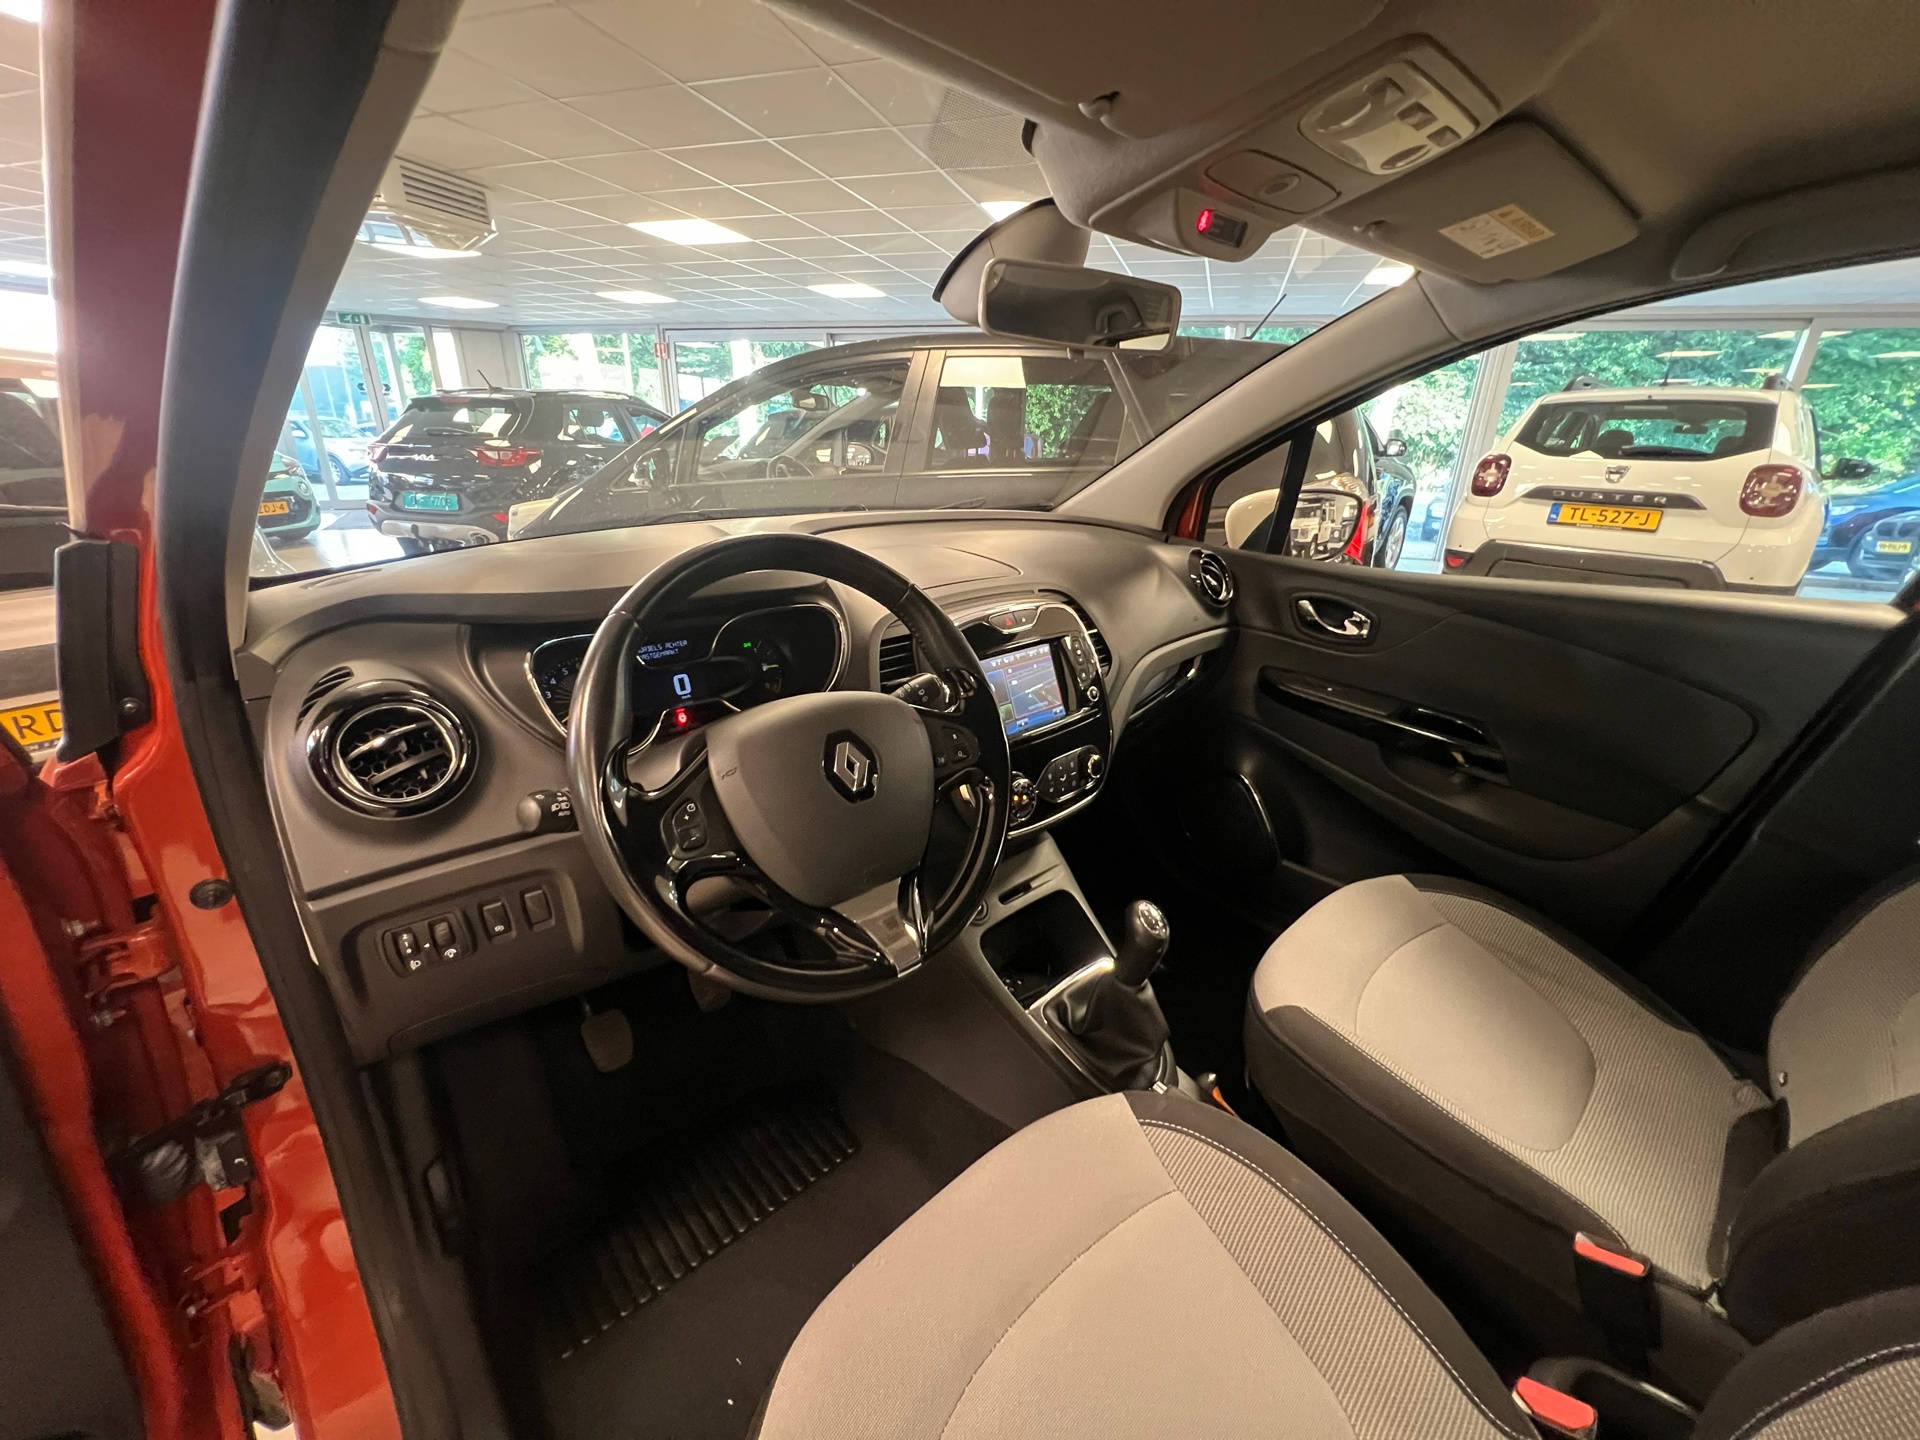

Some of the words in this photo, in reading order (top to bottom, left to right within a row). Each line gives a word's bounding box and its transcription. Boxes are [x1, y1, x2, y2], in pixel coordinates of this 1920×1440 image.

[1552, 489, 1667, 505] DUSTER
[1570, 507, 1651, 526] TL-527-J
[561, 667, 569, 676] 5
[549, 677, 557, 685] 4
[673, 673, 692, 696] 0
[545, 691, 552, 699] 3
